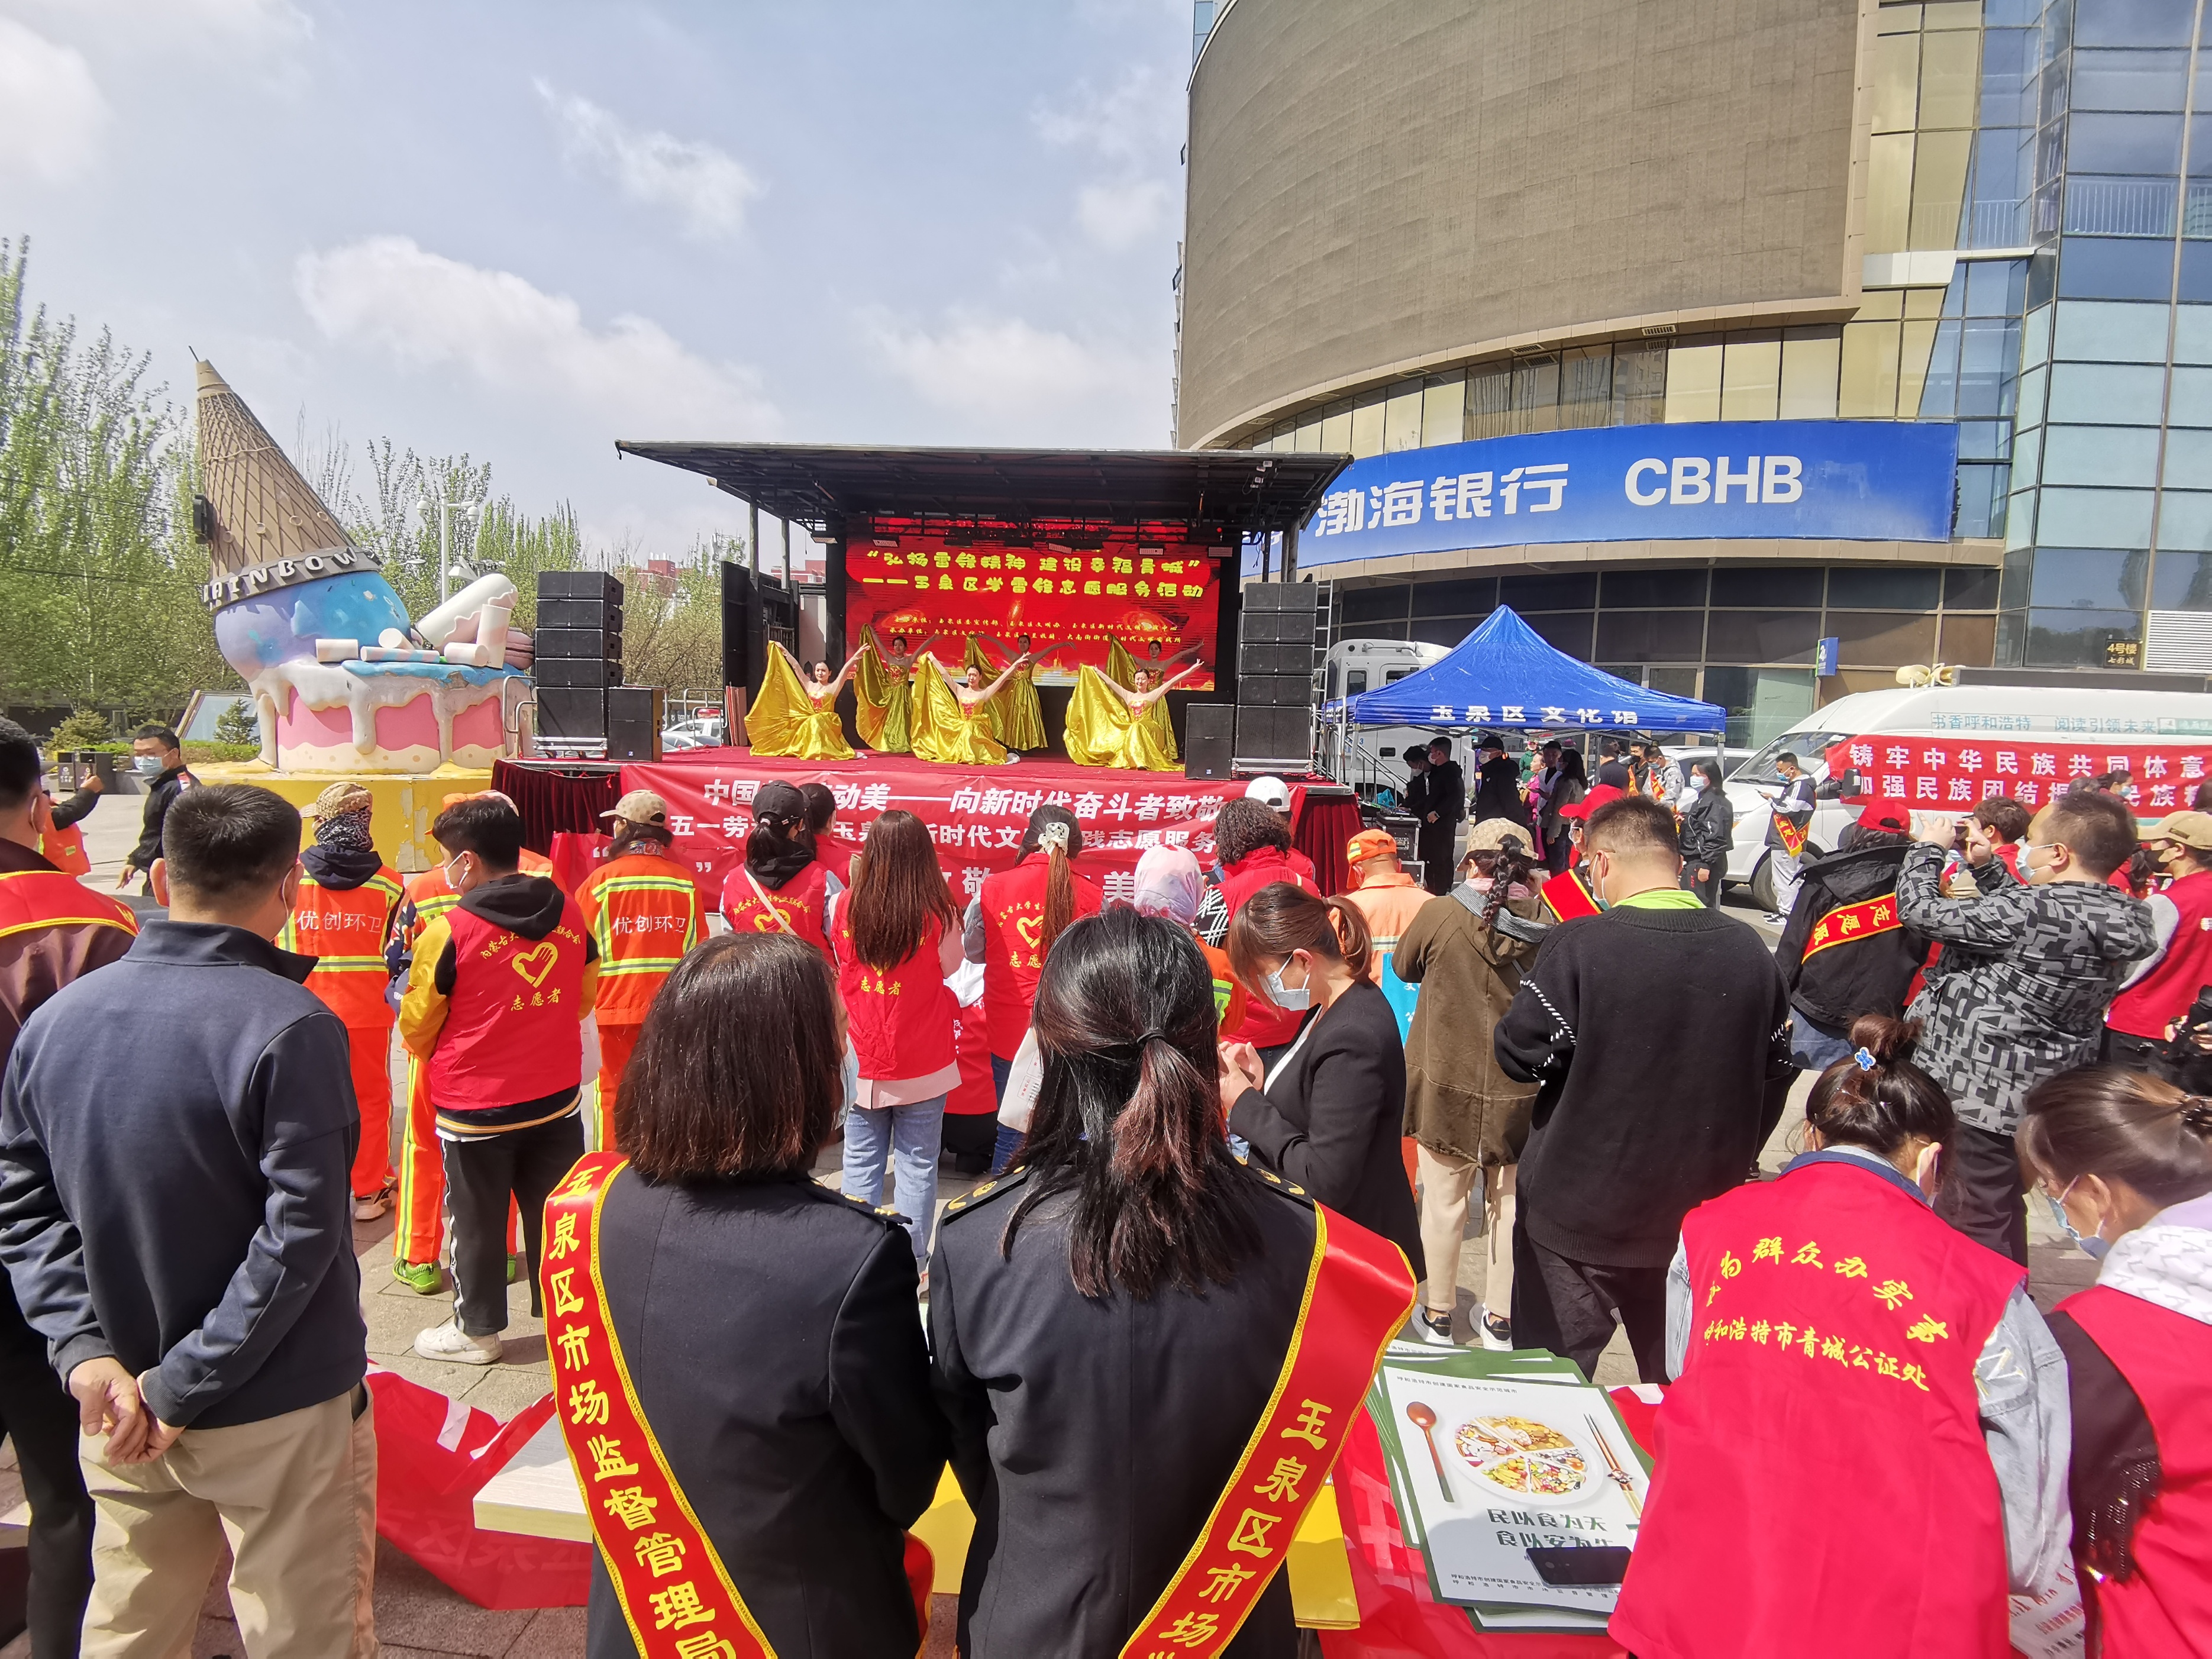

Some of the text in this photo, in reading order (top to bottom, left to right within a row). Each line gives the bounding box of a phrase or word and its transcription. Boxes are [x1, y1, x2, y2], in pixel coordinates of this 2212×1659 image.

[1315, 456, 1803, 537] 渤海银行 CBHB
[2107, 643, 2137, 654] 4号楼
[1931, 714, 2032, 731] 书香呼和浩特
[2054, 716, 2157, 734] 阅读引领未来
[1849, 743, 2205, 779] 铸牢中华民族共同体意
[296, 911, 382, 932] 优创环卫
[613, 915, 685, 934] 优创环卫
[861, 976, 902, 996] 志愿者
[511, 987, 561, 1012] 志愿者
[1148, 1399, 1332, 1659] 玉泉区市场
[1487, 1508, 1608, 1532] 民以食为天
